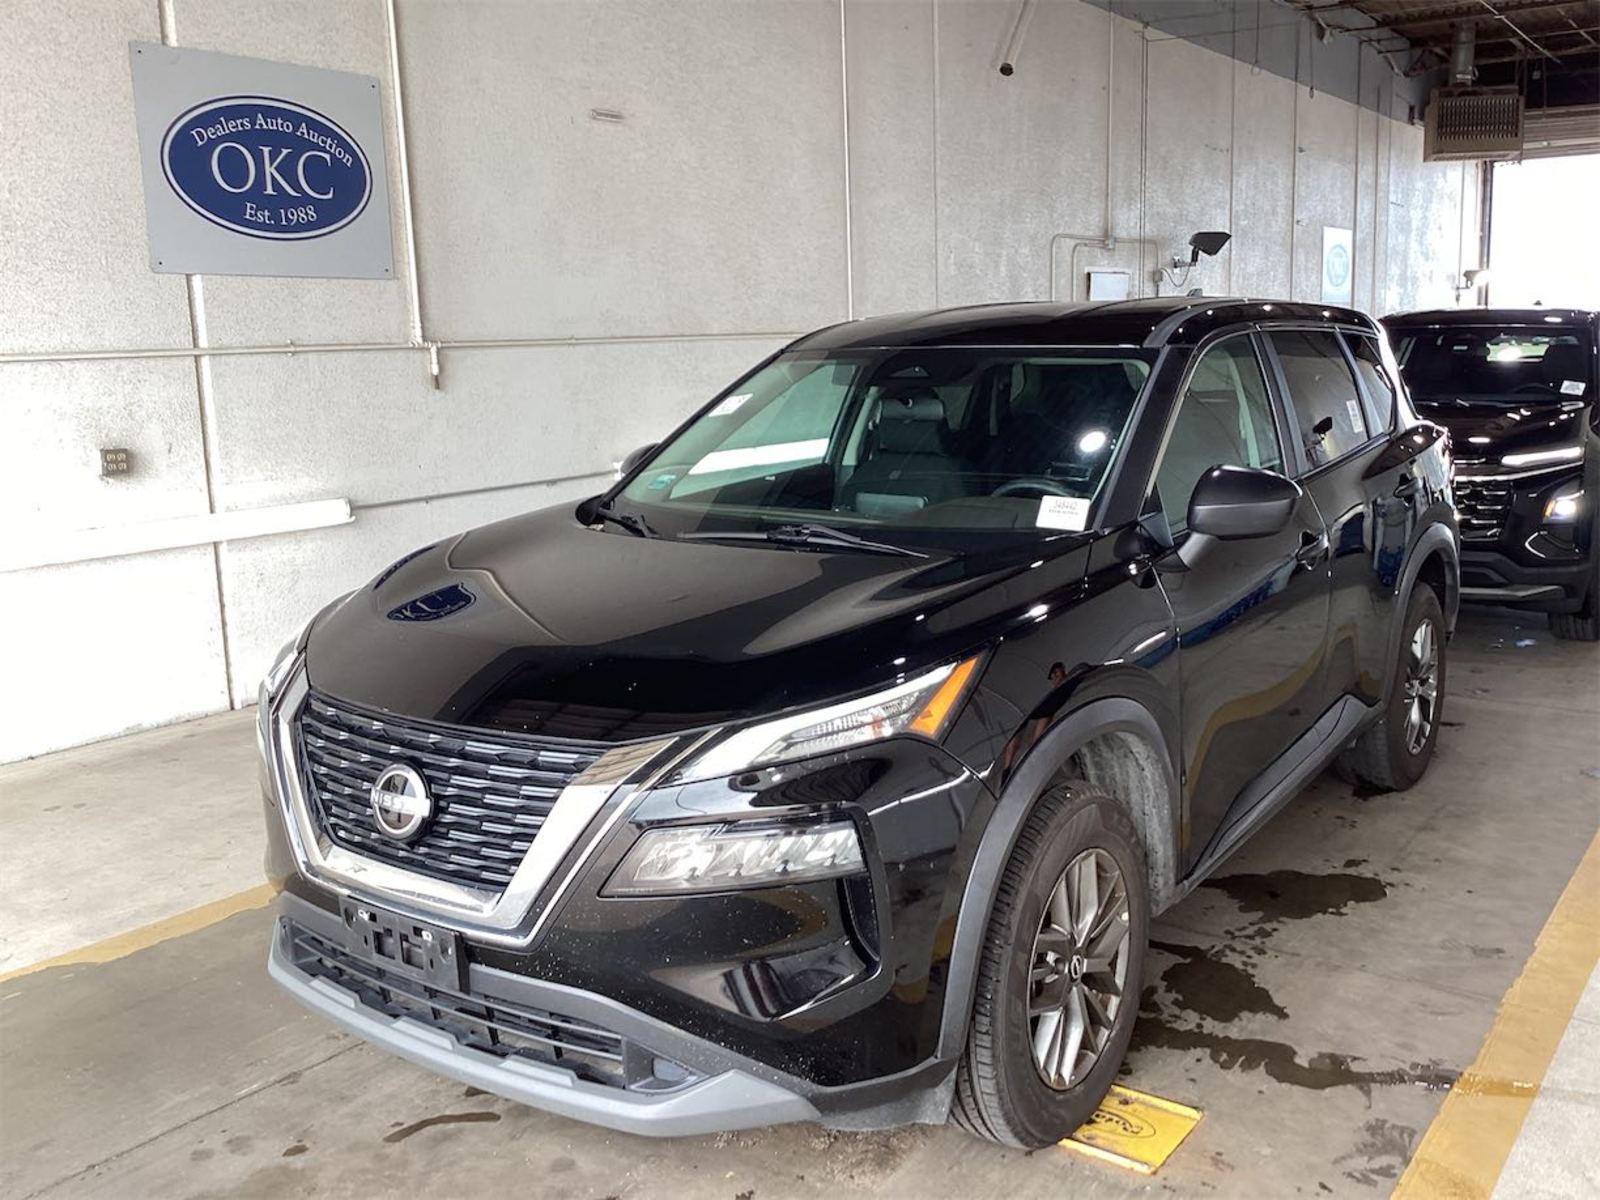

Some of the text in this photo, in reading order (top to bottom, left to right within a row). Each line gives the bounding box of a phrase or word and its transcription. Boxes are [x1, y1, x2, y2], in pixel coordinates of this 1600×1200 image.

[190, 112, 354, 168] Dealers Auto Auction
[211, 141, 335, 200] OKC
[243, 201, 318, 227] Est. 1988
